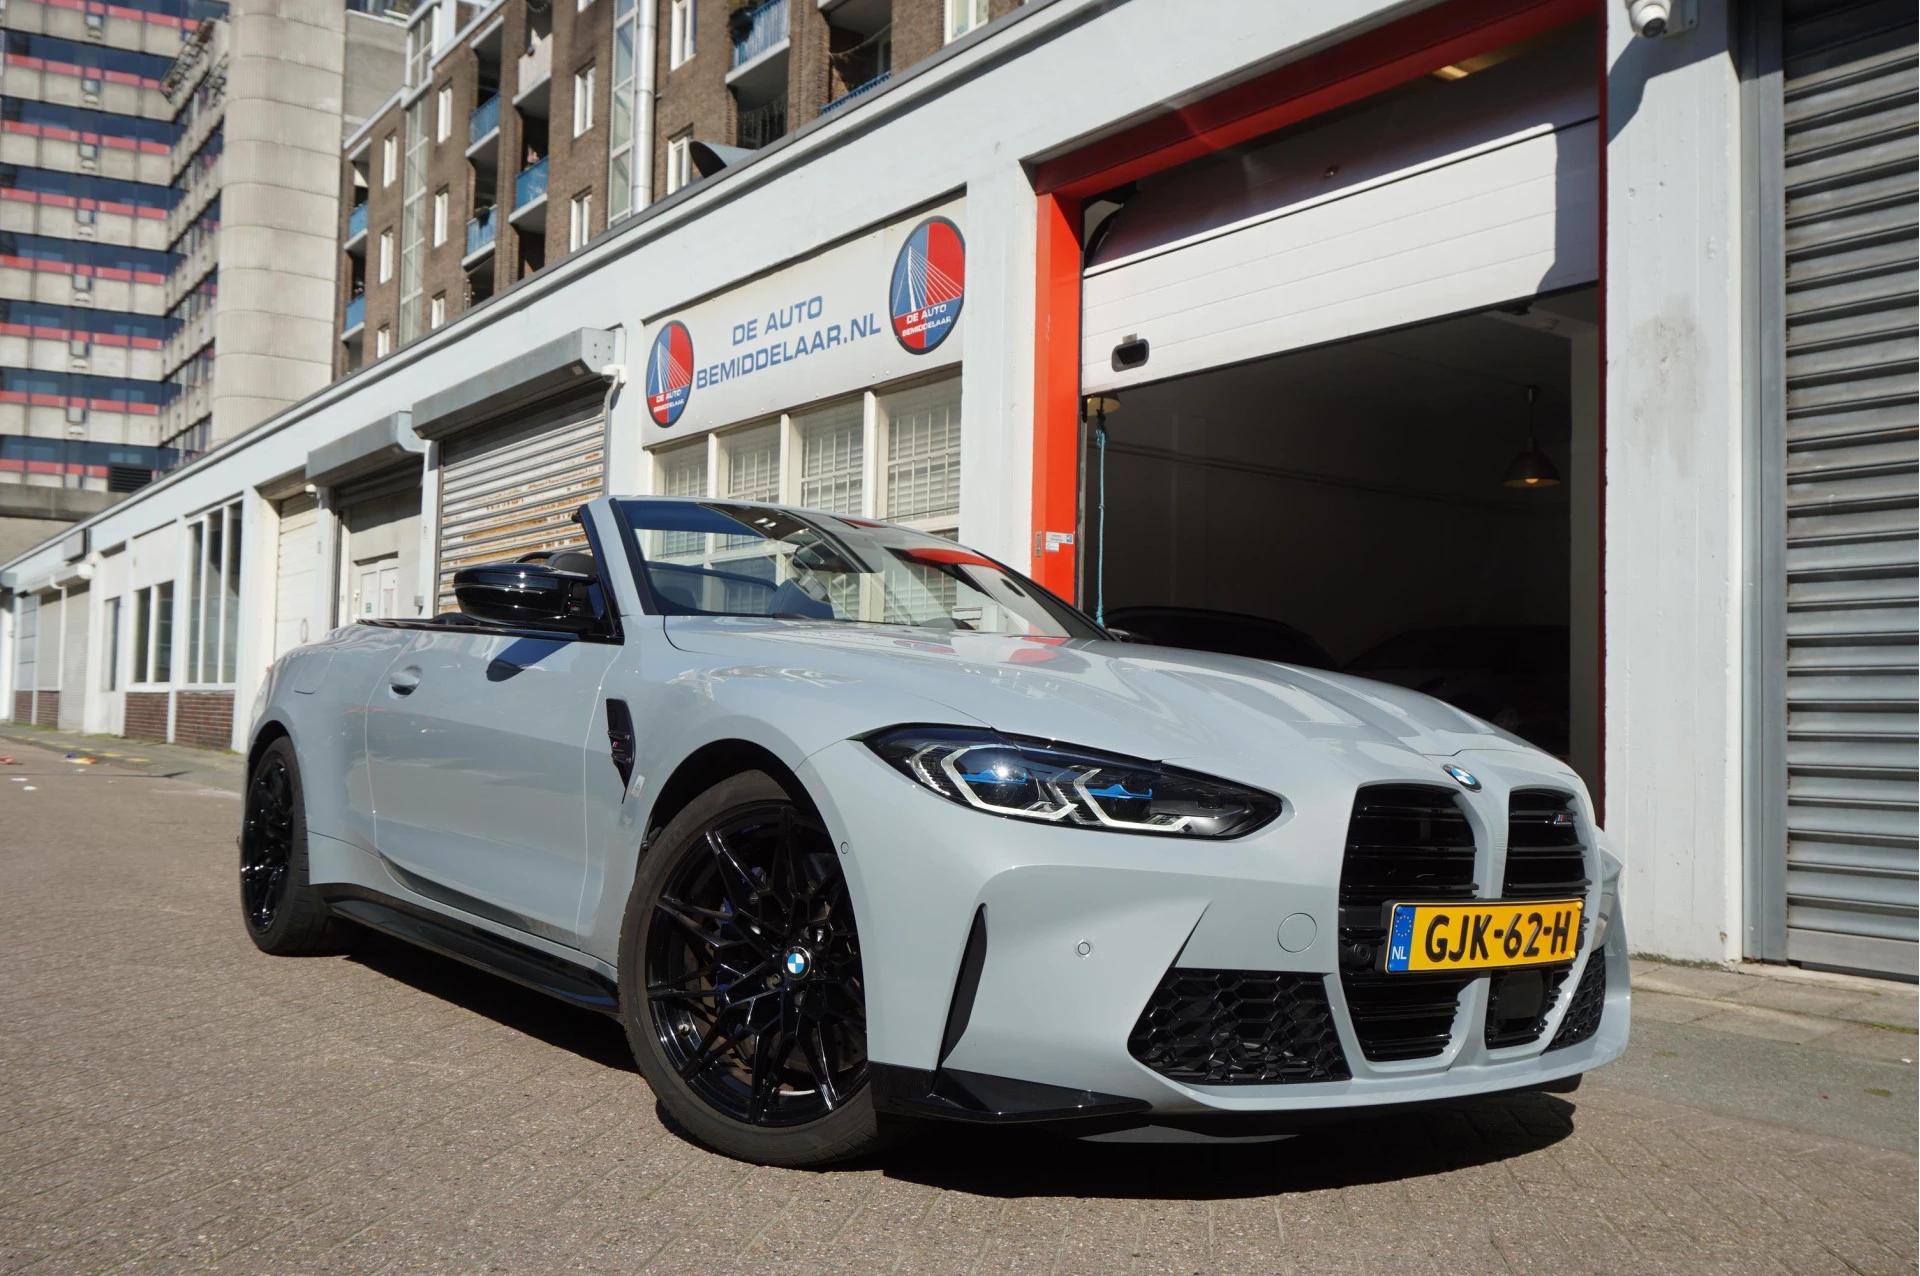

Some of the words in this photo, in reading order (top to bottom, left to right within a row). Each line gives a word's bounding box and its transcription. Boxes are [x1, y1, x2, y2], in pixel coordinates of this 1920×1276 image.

[732, 318, 758, 346] DE
[764, 295, 823, 335] AUTO
[906, 312, 919, 325] DE
[921, 303, 947, 320] AUTO
[696, 313, 881, 390] BEMIDDELAAR.NL
[1391, 946, 1407, 960] NL
[1424, 910, 1572, 963] GJK-62-H
